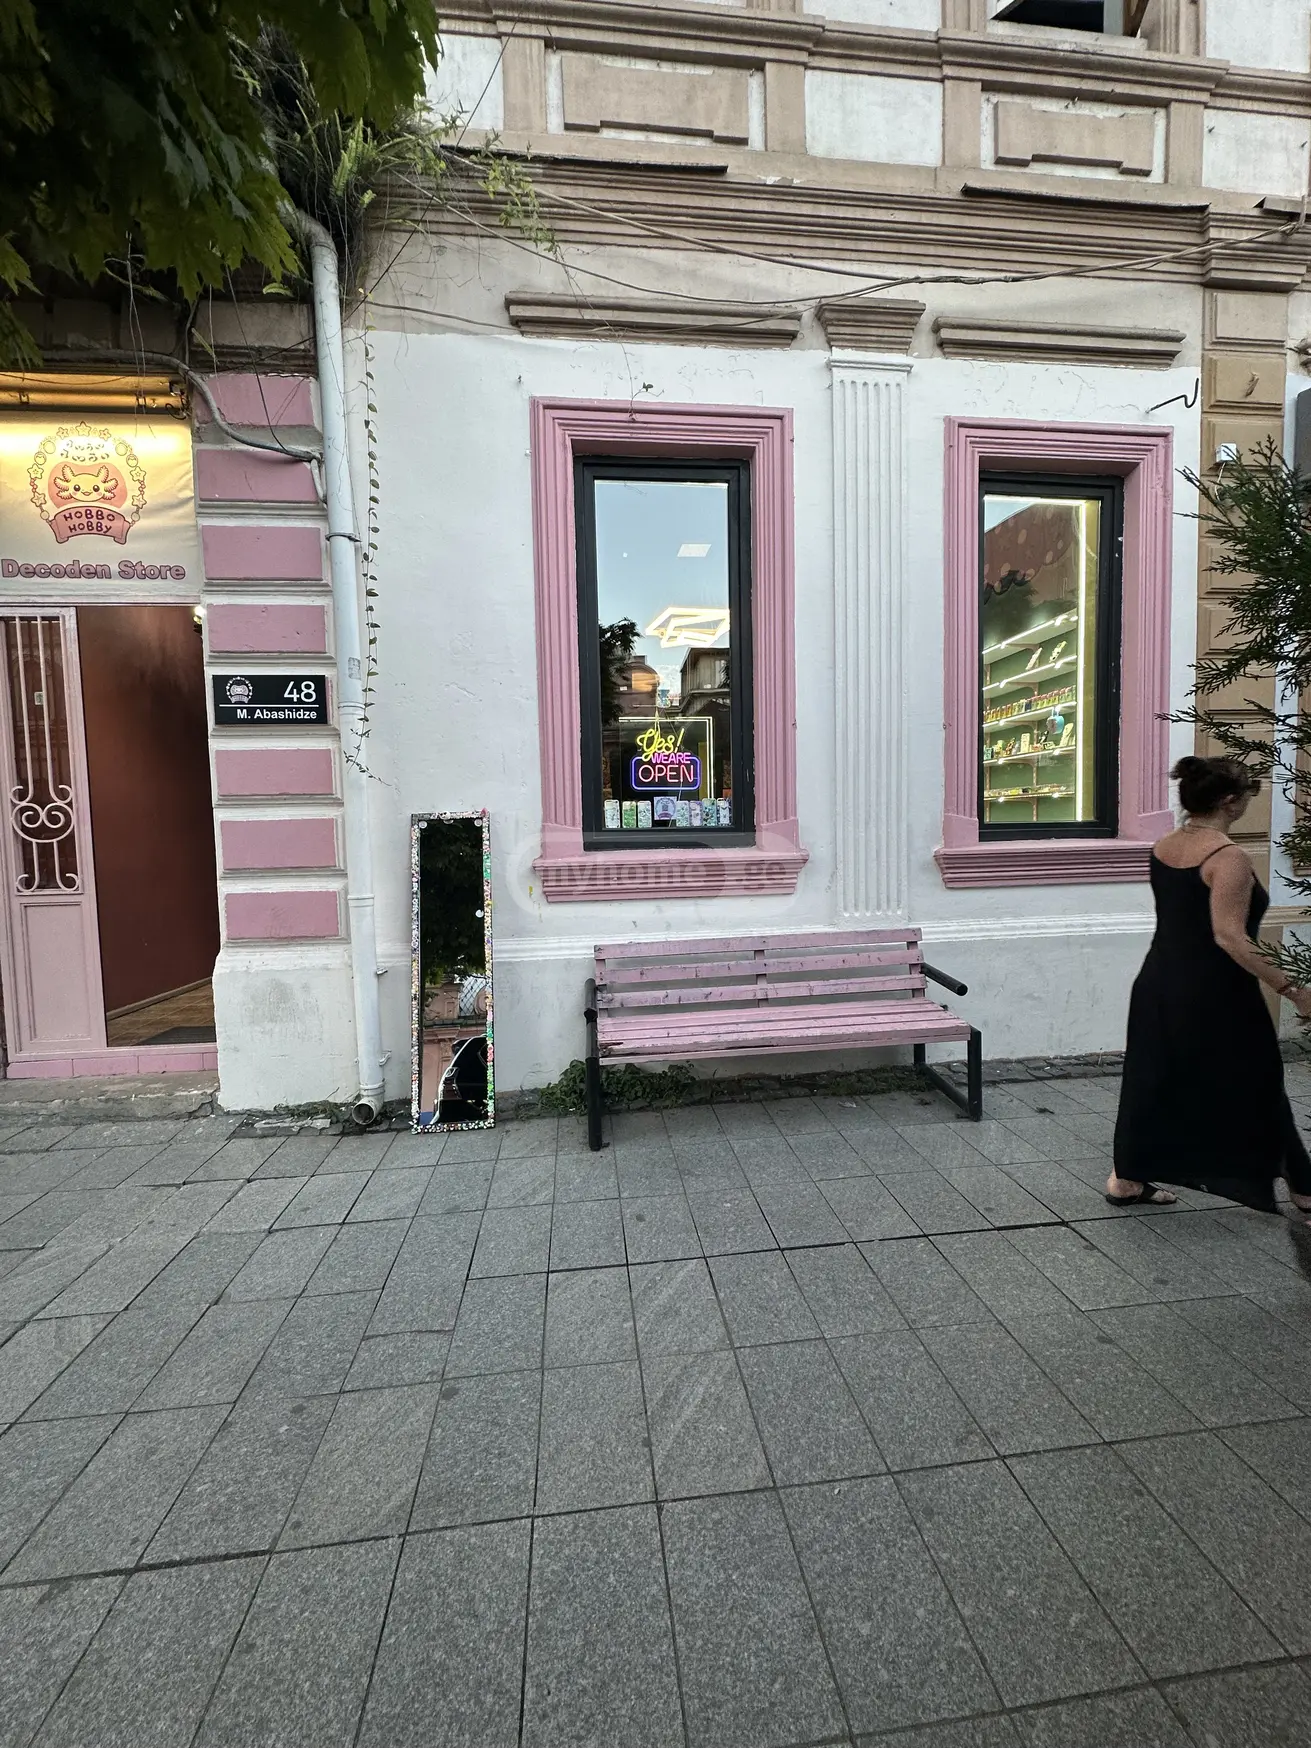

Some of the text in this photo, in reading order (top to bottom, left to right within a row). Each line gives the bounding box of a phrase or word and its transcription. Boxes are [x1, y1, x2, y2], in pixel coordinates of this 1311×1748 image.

[63, 508, 115, 521] HOBBO
[1, 559, 186, 580] Decoden Store
[283, 680, 317, 703] 48
[236, 708, 317, 719] M. Abashidze
[636, 727, 685, 762] Yes!
[638, 764, 694, 783] OPEN
